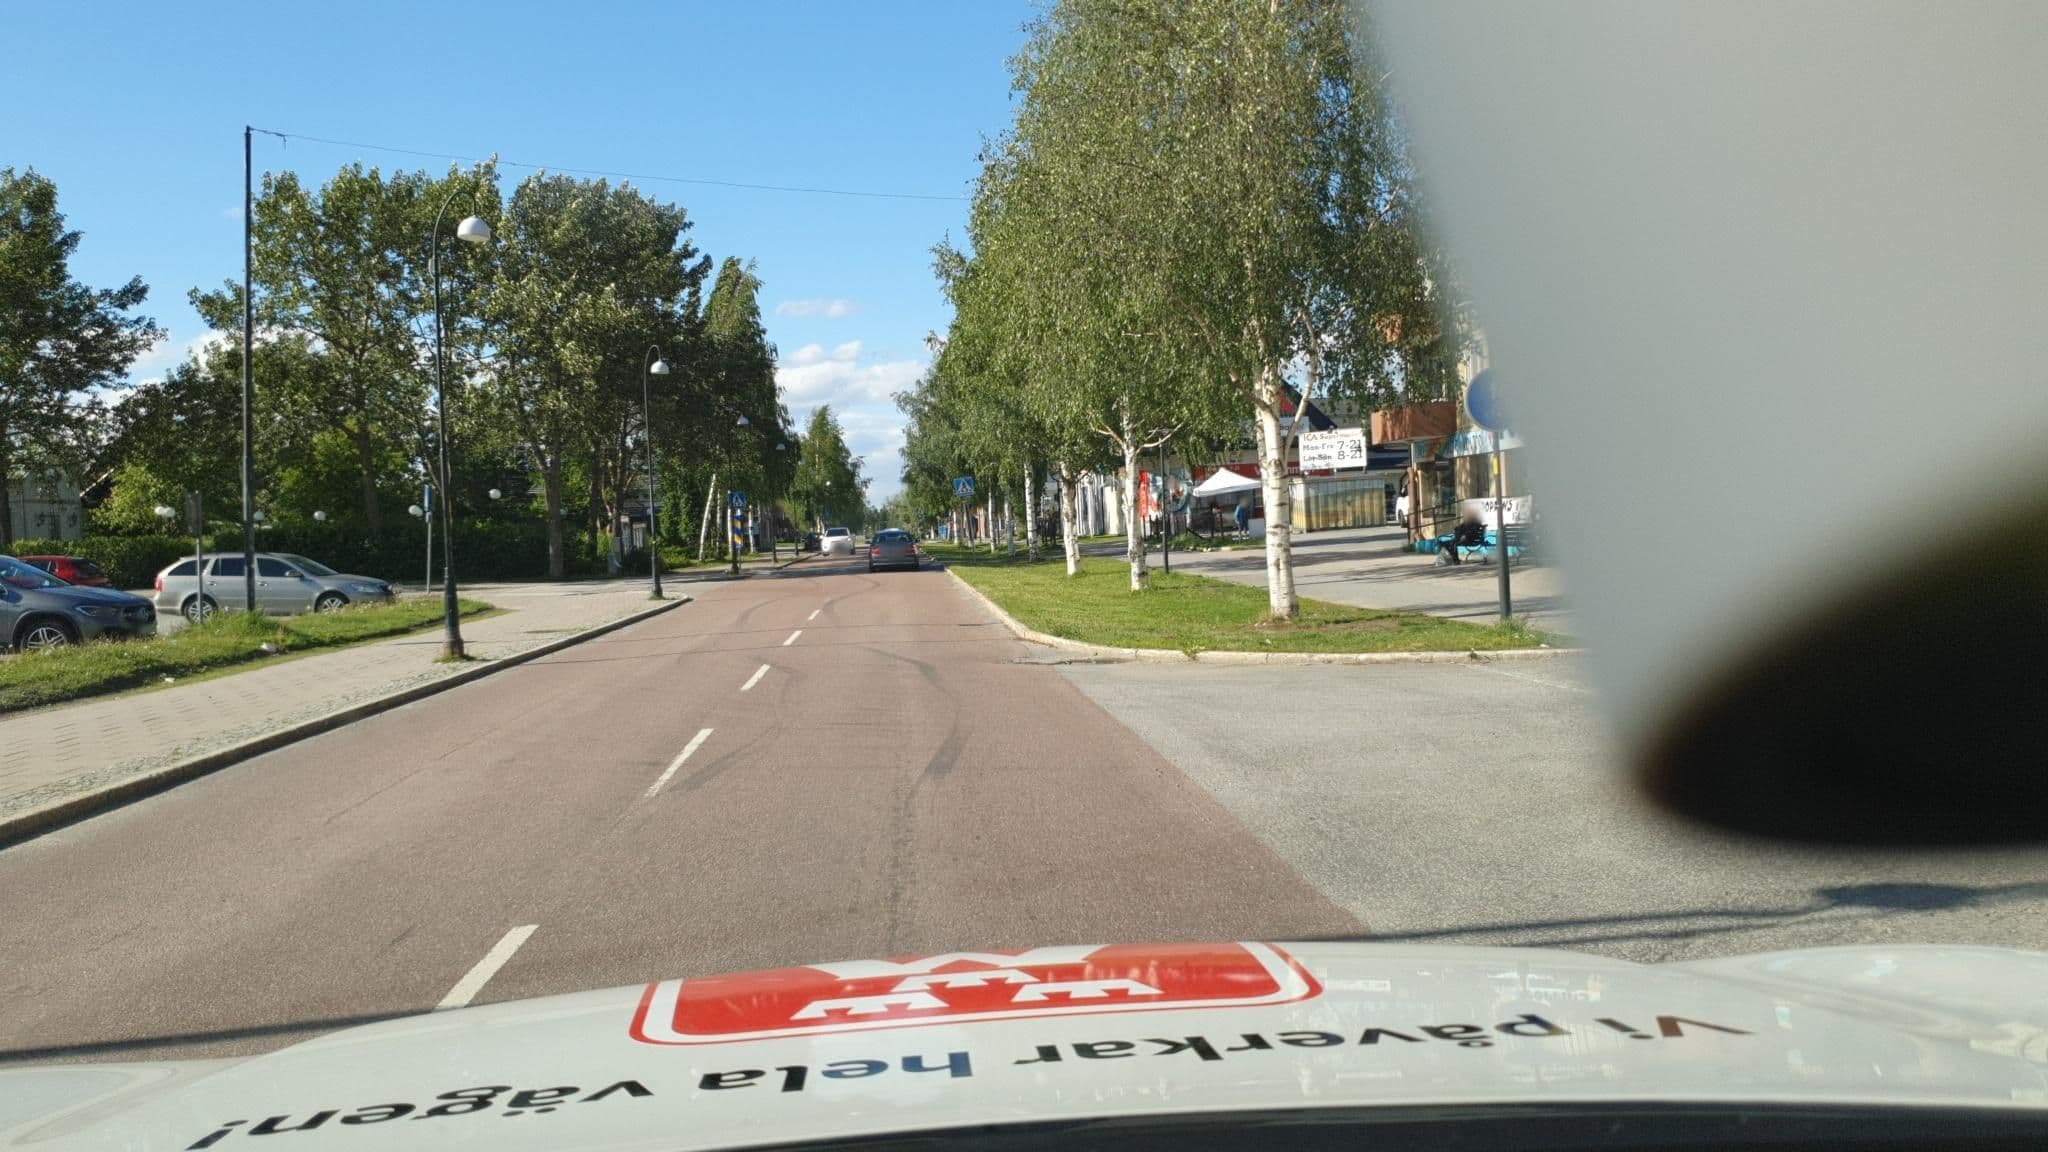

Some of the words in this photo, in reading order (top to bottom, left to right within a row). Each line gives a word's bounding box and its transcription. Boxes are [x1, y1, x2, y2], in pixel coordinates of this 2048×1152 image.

[1303, 433, 1318, 441] ICA
[1337, 439, 1362, 450] 7-21
[1337, 449, 1362, 460] 8-21
[1014, 1013, 1573, 1065] påverkar
[1595, 1014, 1757, 1039] Vi
[699, 1051, 973, 1092] hela
[184, 1080, 654, 1151] vägen!
